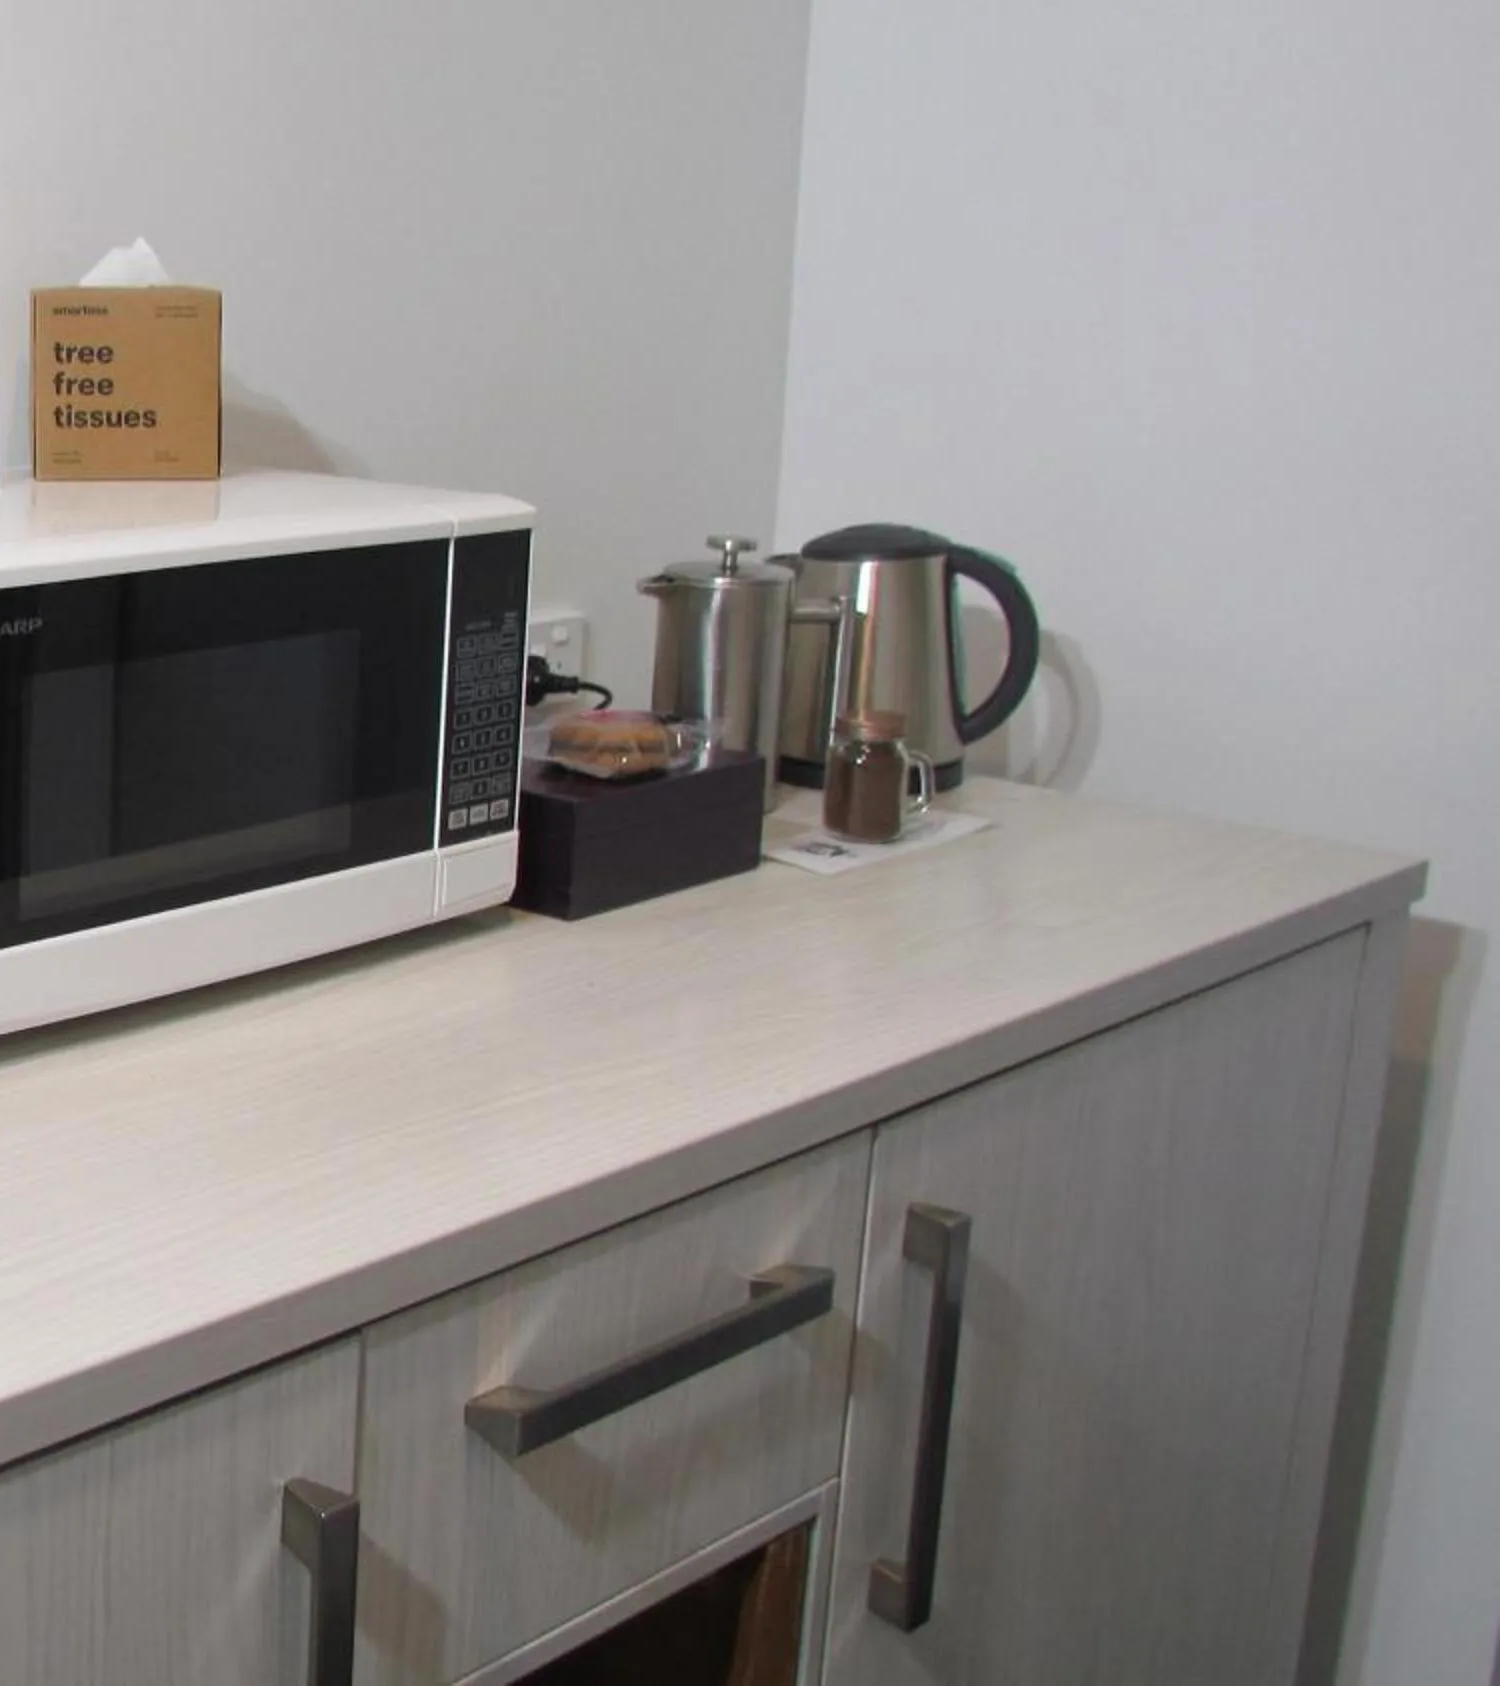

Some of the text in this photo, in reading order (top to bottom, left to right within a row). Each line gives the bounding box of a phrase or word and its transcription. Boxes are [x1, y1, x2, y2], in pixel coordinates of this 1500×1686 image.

[54, 341, 114, 364] tree
[53, 371, 114, 396] free
[54, 405, 157, 429] tissues
